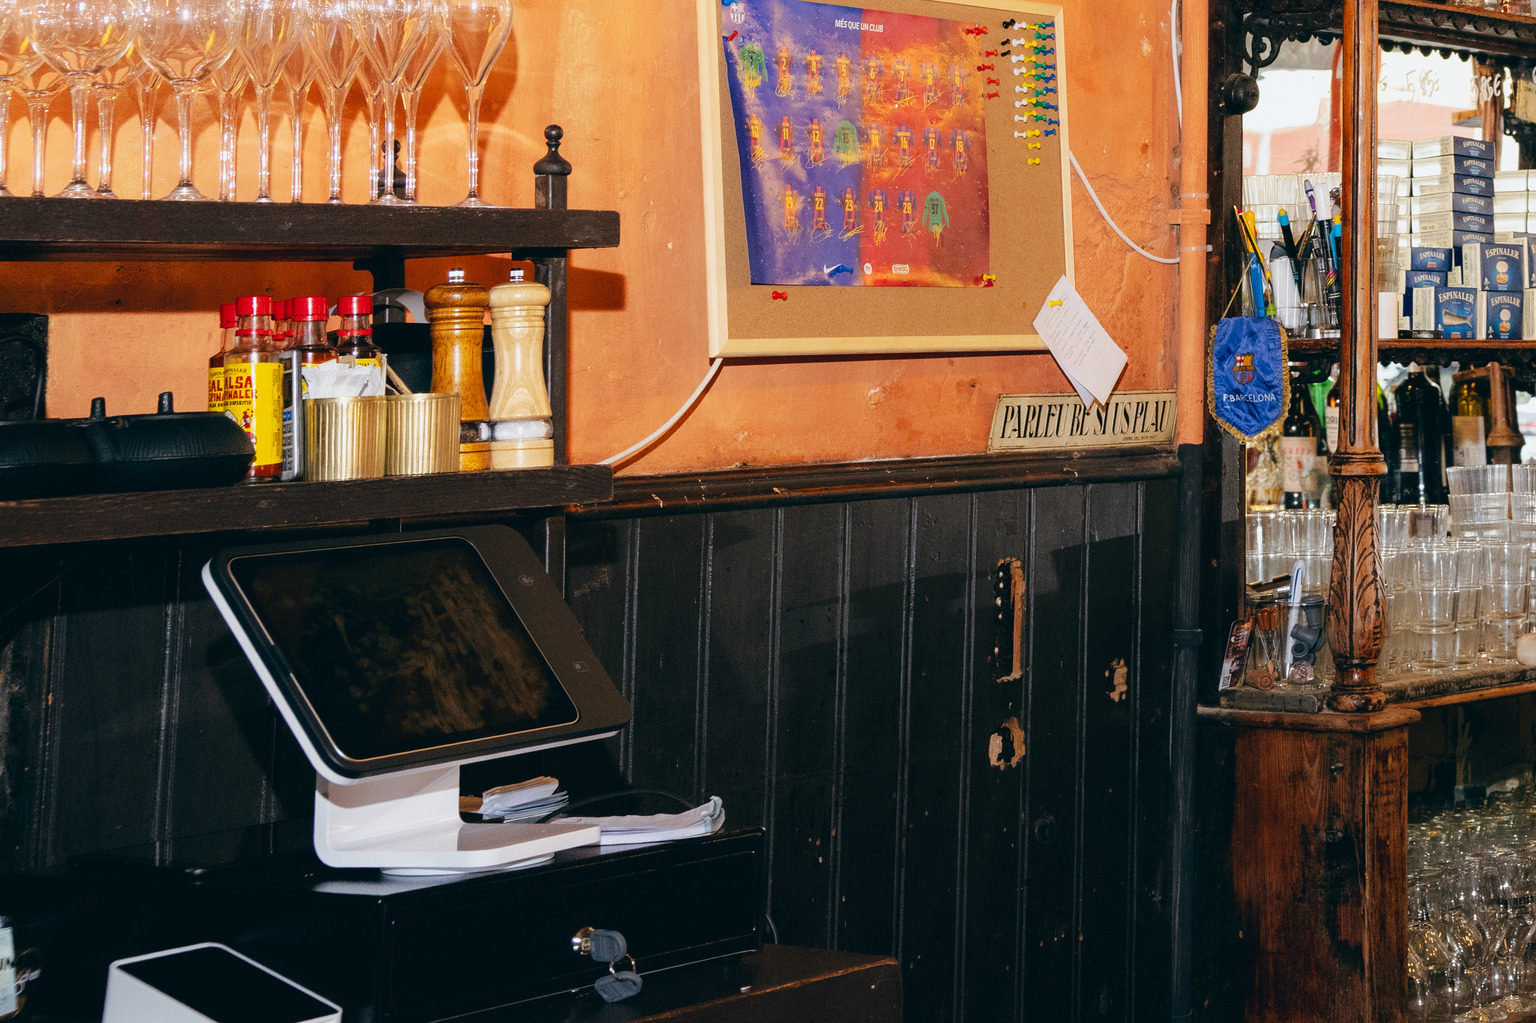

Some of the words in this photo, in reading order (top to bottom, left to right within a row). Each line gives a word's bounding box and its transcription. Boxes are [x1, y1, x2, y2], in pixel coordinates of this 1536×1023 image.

[835, 19, 848, 28] MÉS
[848, 20, 860, 30] QUE
[860, 22, 869, 31] UN
[869, 23, 884, 33] CLUB
[782, 127, 790, 141] 11
[811, 130, 820, 143] 12
[929, 137, 936, 150] 17
[955, 140, 964, 153] 18
[815, 197, 824, 210] 22
[874, 200, 883, 213] 24
[903, 201, 912, 214] 28
[1419, 251, 1446, 261] ESPINALER
[1485, 247, 1520, 260] ESPINALER
[1414, 274, 1441, 284] ESPINALER
[1438, 290, 1475, 304] ESPINALER
[1490, 295, 1521, 307] ESPINALER
[1000, 403, 1070, 439] PARLEU
[1111, 401, 1132, 434] US
[1131, 400, 1172, 433] PLAU
